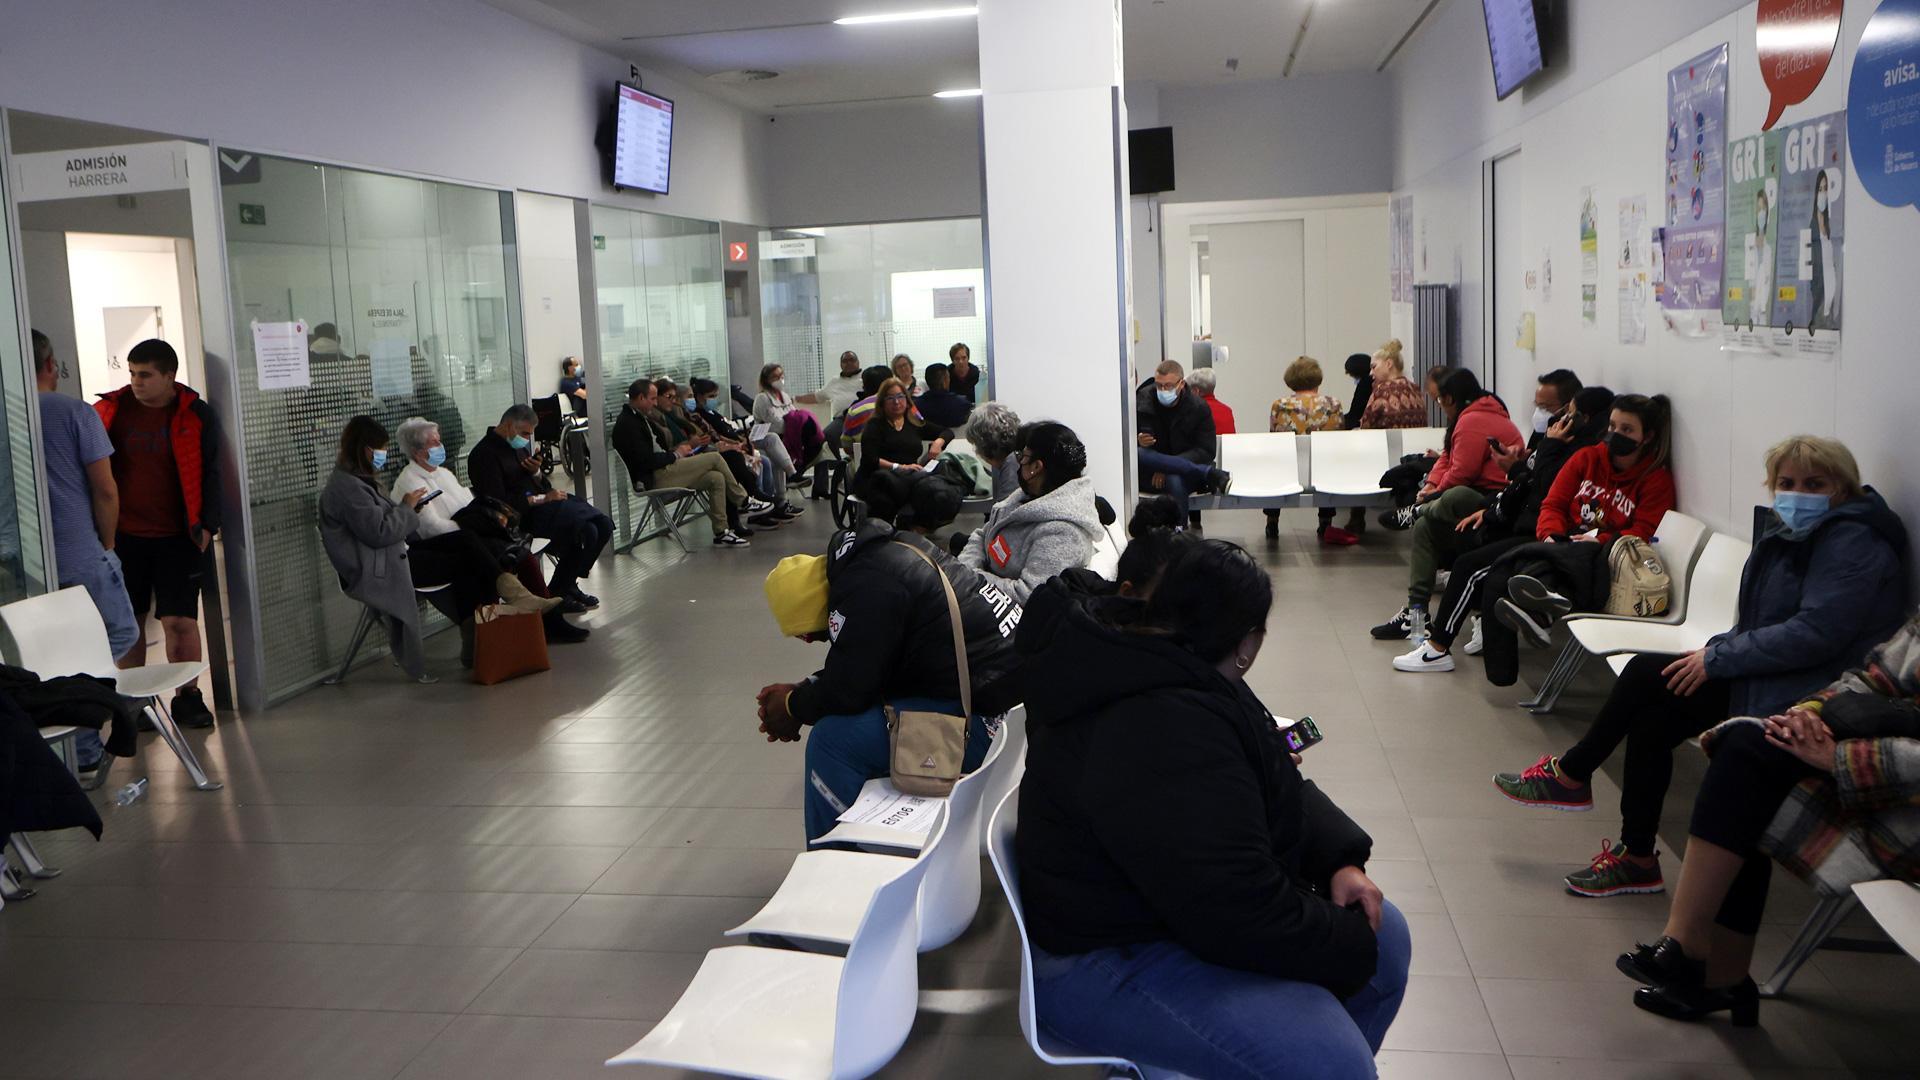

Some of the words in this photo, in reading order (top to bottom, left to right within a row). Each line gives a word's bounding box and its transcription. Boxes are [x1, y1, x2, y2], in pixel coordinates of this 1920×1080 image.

[1883, 59, 1920, 88] avisa.
[65, 152, 127, 172] ADMISIÓN
[1732, 136, 1764, 183] GRI
[68, 171, 128, 188] HARRERA
[882, 806, 914, 826] E0706
